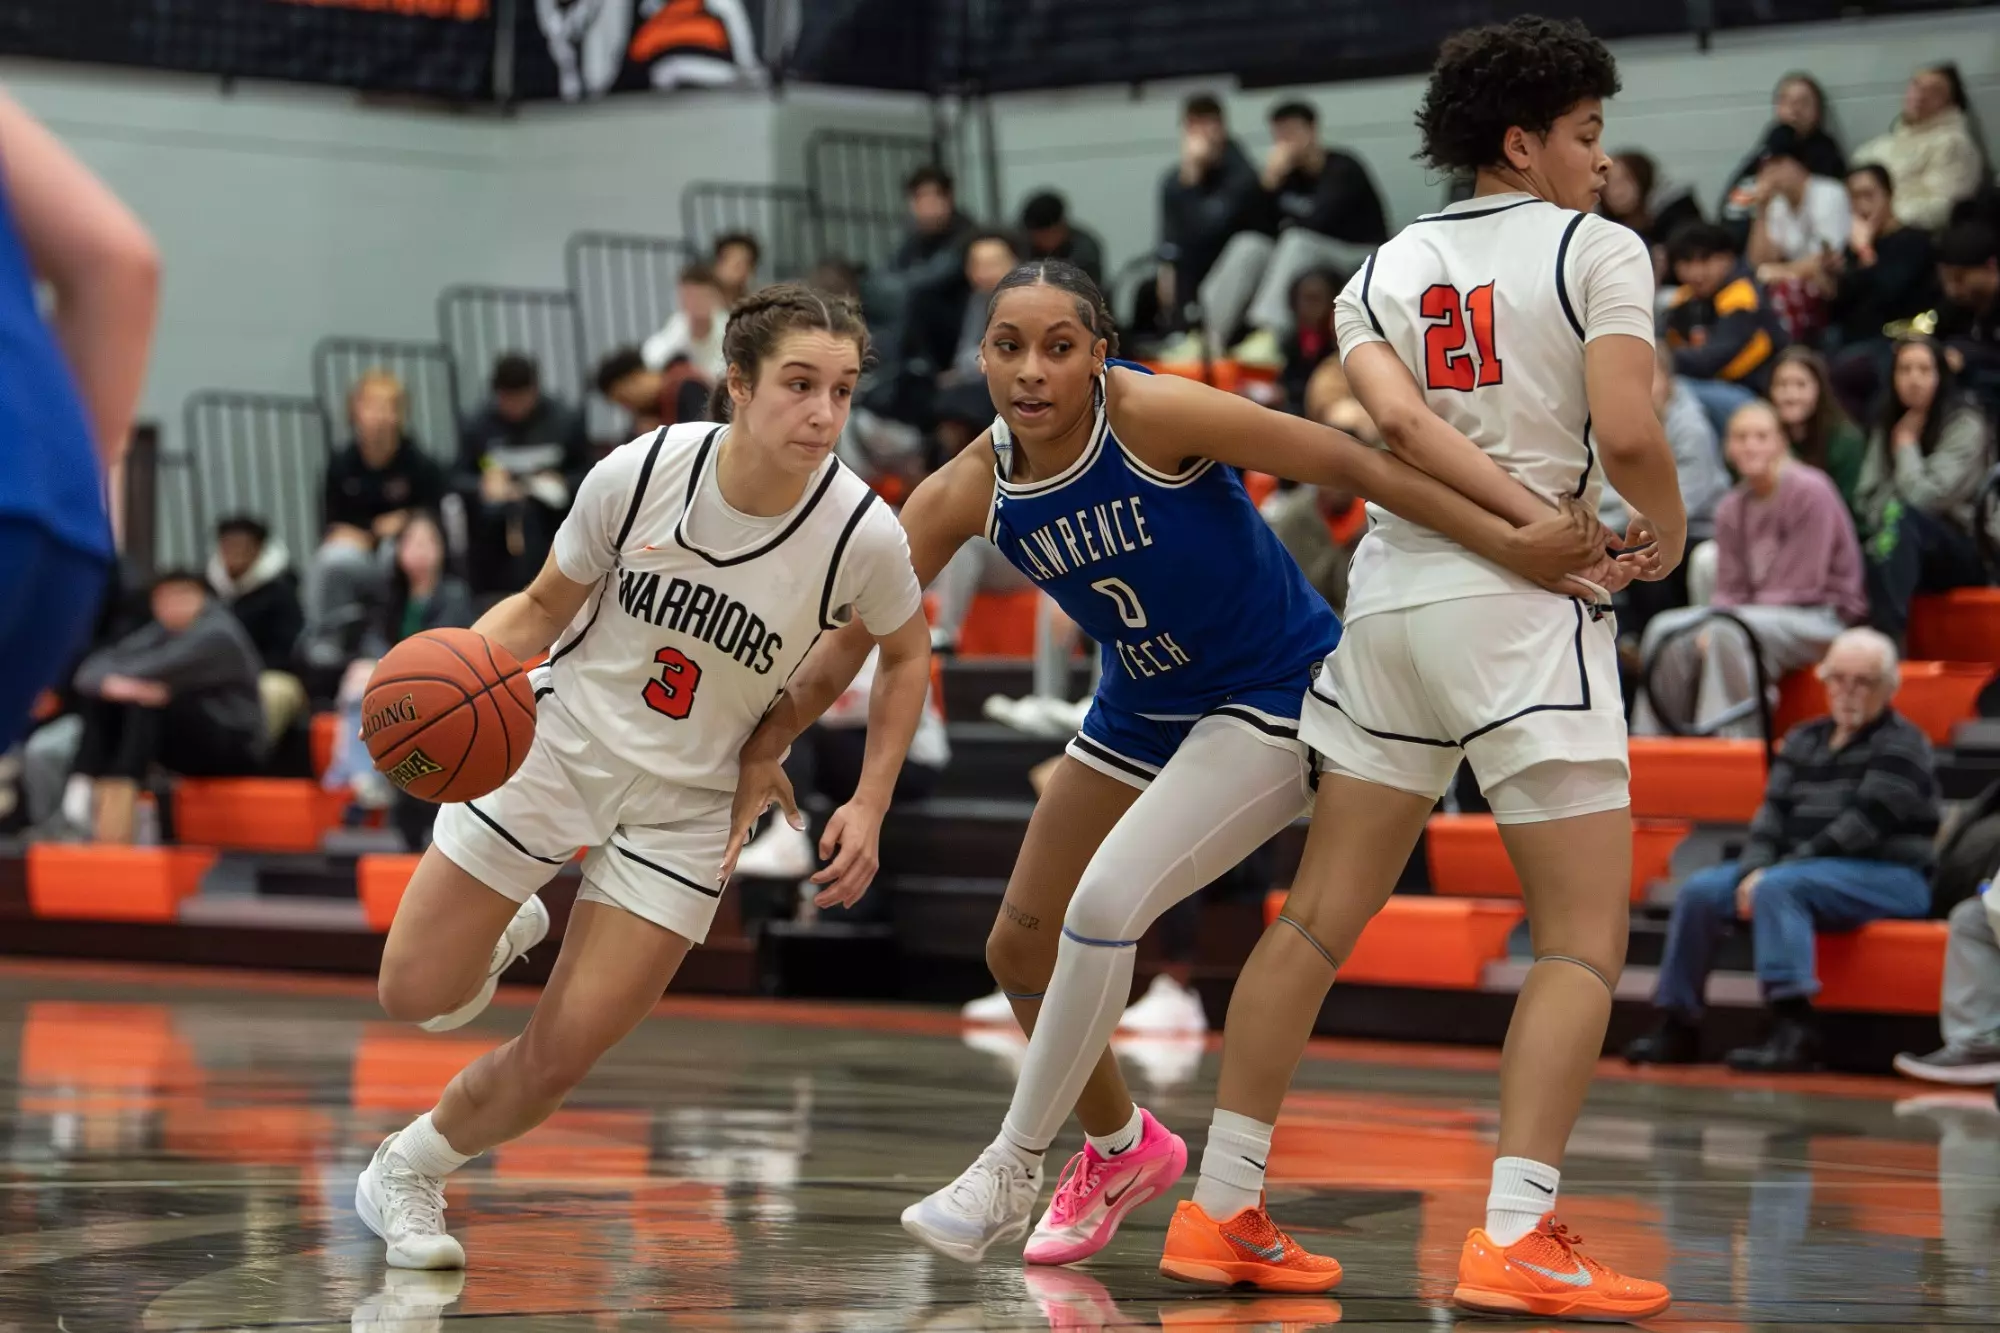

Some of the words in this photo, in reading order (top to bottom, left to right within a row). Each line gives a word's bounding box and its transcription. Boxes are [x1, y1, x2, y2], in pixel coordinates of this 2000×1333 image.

[1420, 279, 1503, 392] 21
[618, 568, 783, 675] WARRIORS
[1116, 632, 1190, 680] TECH
[363, 693, 416, 738] ALDING
[641, 646, 702, 720] 3
